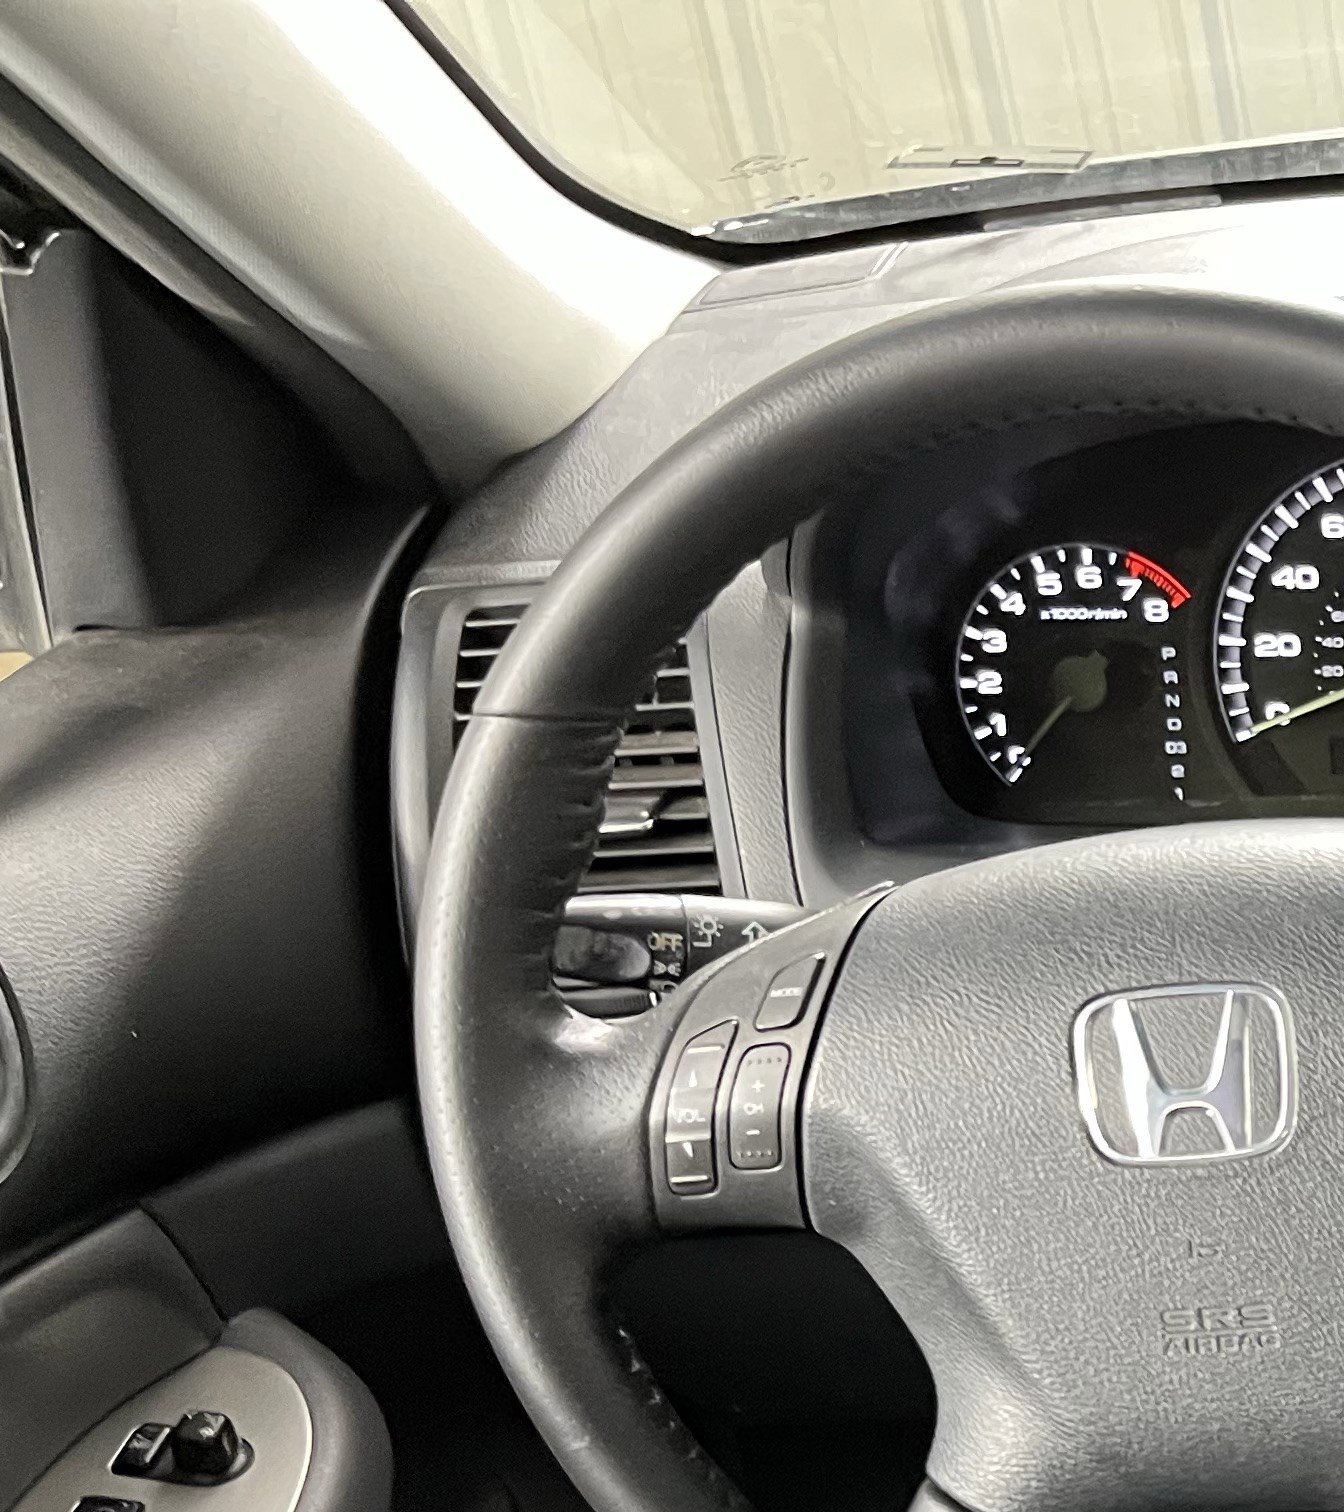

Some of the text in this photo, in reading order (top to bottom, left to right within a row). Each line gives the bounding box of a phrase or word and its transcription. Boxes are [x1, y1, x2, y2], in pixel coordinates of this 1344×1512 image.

[1037, 571, 1062, 596] 5
[1076, 565, 1101, 589] 6
[1117, 577, 1142, 601] 7
[1270, 565, 1320, 590] 40
[1000, 592, 1026, 616] 4
[1143, 597, 1169, 622] 8
[982, 628, 1007, 653] 3
[1253, 633, 1301, 658] 20
[975, 670, 1003, 695] 2
[1165, 693, 1180, 707] N
[990, 714, 1006, 736] 1
[647, 931, 683, 951] OFF
